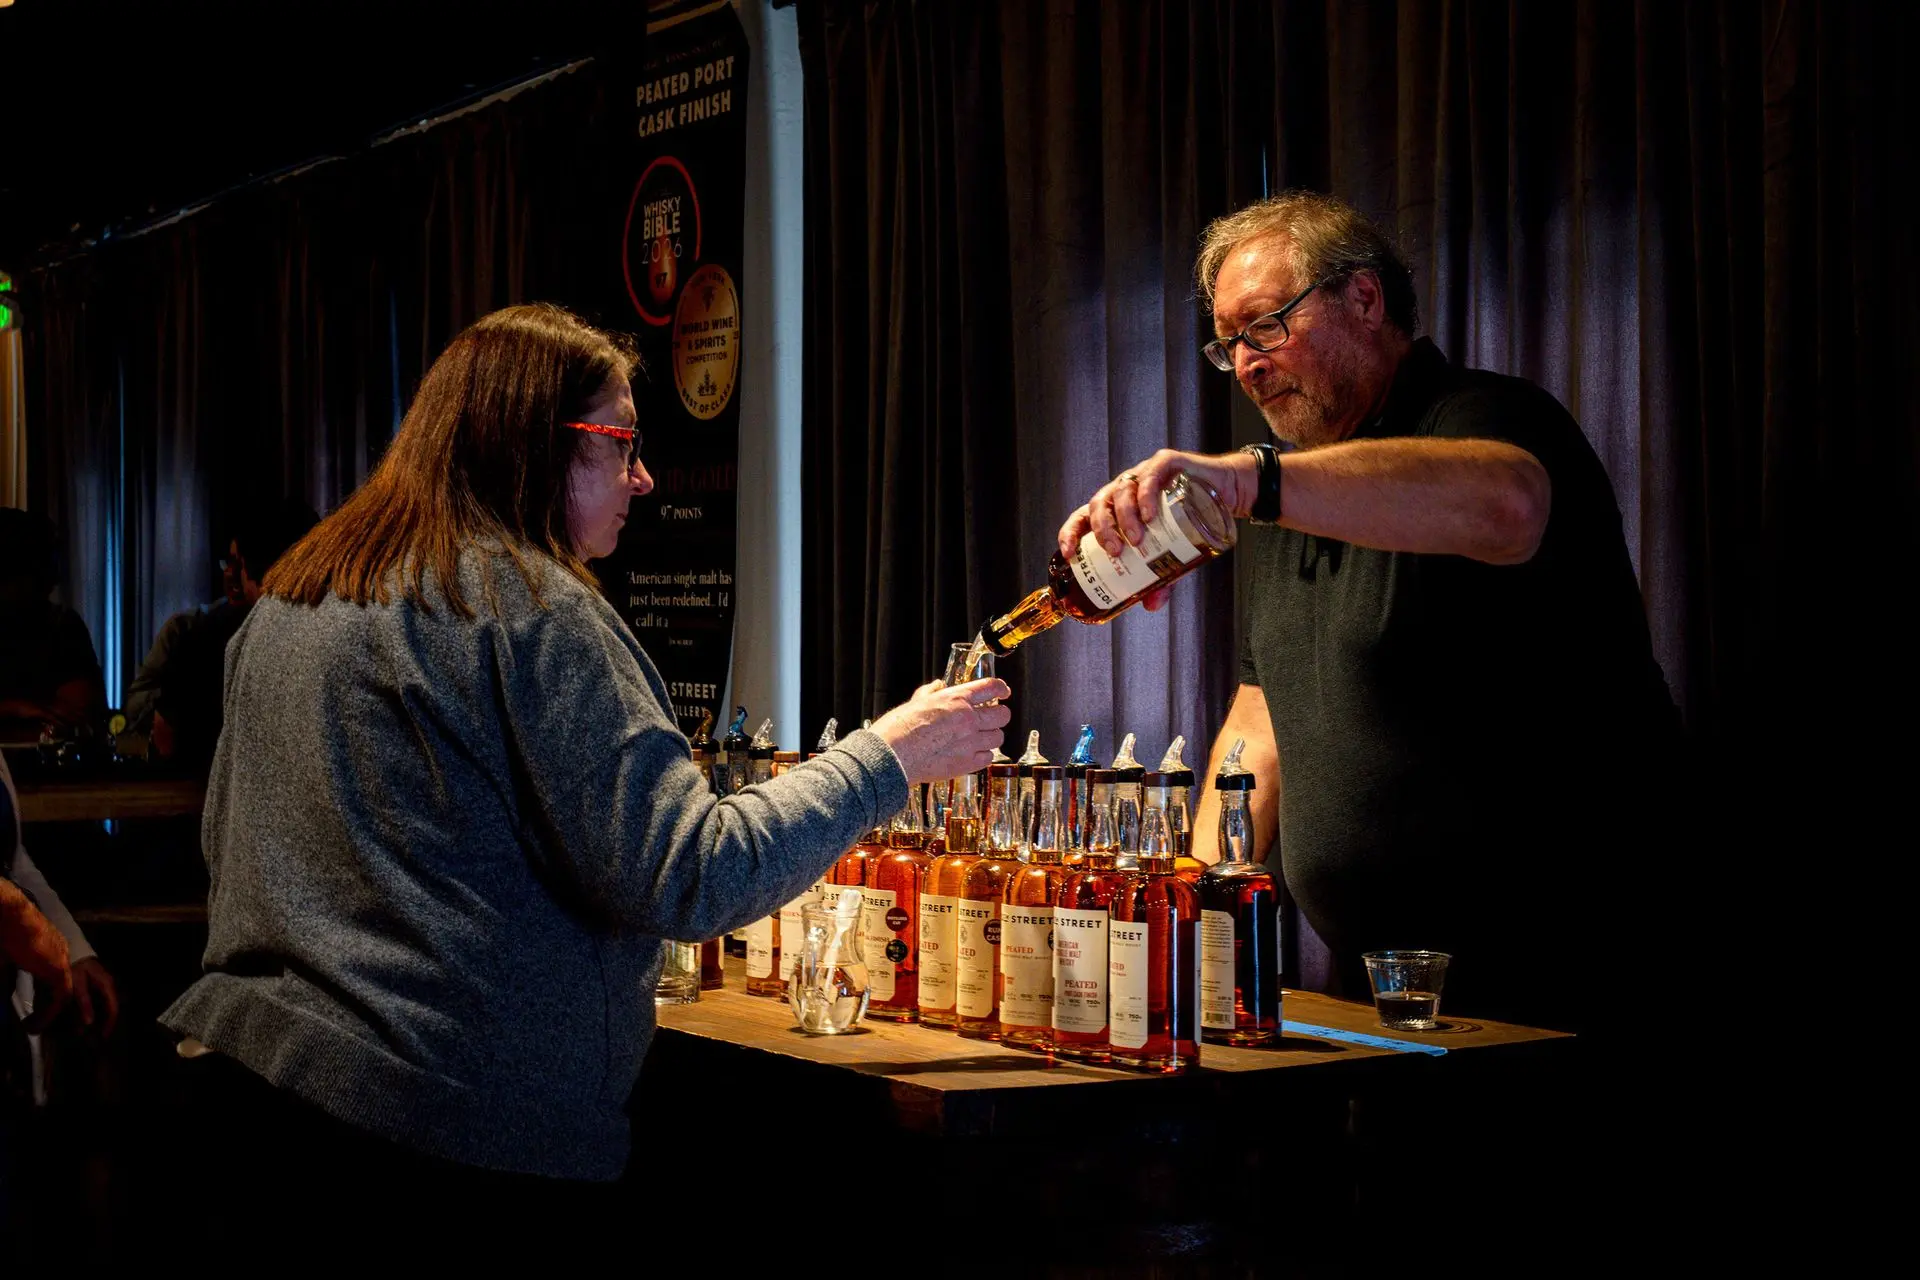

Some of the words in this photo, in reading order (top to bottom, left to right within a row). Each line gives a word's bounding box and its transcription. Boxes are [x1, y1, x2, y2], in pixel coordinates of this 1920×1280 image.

[636, 71, 690, 108] PEATED
[694, 55, 736, 89] PORT
[638, 107, 676, 138] CASK
[679, 88, 732, 126] FINISH
[643, 195, 682, 219] WHISKY
[643, 211, 681, 241] BIBLE
[640, 236, 683, 265] 2026
[681, 321, 710, 335] WORLD
[711, 316, 734, 330] WINE
[694, 335, 727, 350] SPIRITS
[686, 351, 728, 365] COMPETITION
[699, 403, 710, 414] OF
[673, 505, 705, 520] POINTS
[673, 568, 697, 589] single
[698, 569, 718, 585] malt
[719, 568, 733, 585] has
[629, 593, 649, 608] just
[650, 592, 671, 606] been
[635, 612, 654, 628] call
[670, 681, 718, 700] STREET
[1011, 915, 1054, 925] STREET
[1060, 917, 1102, 929] STREET
[1064, 979, 1098, 989] PEATED
